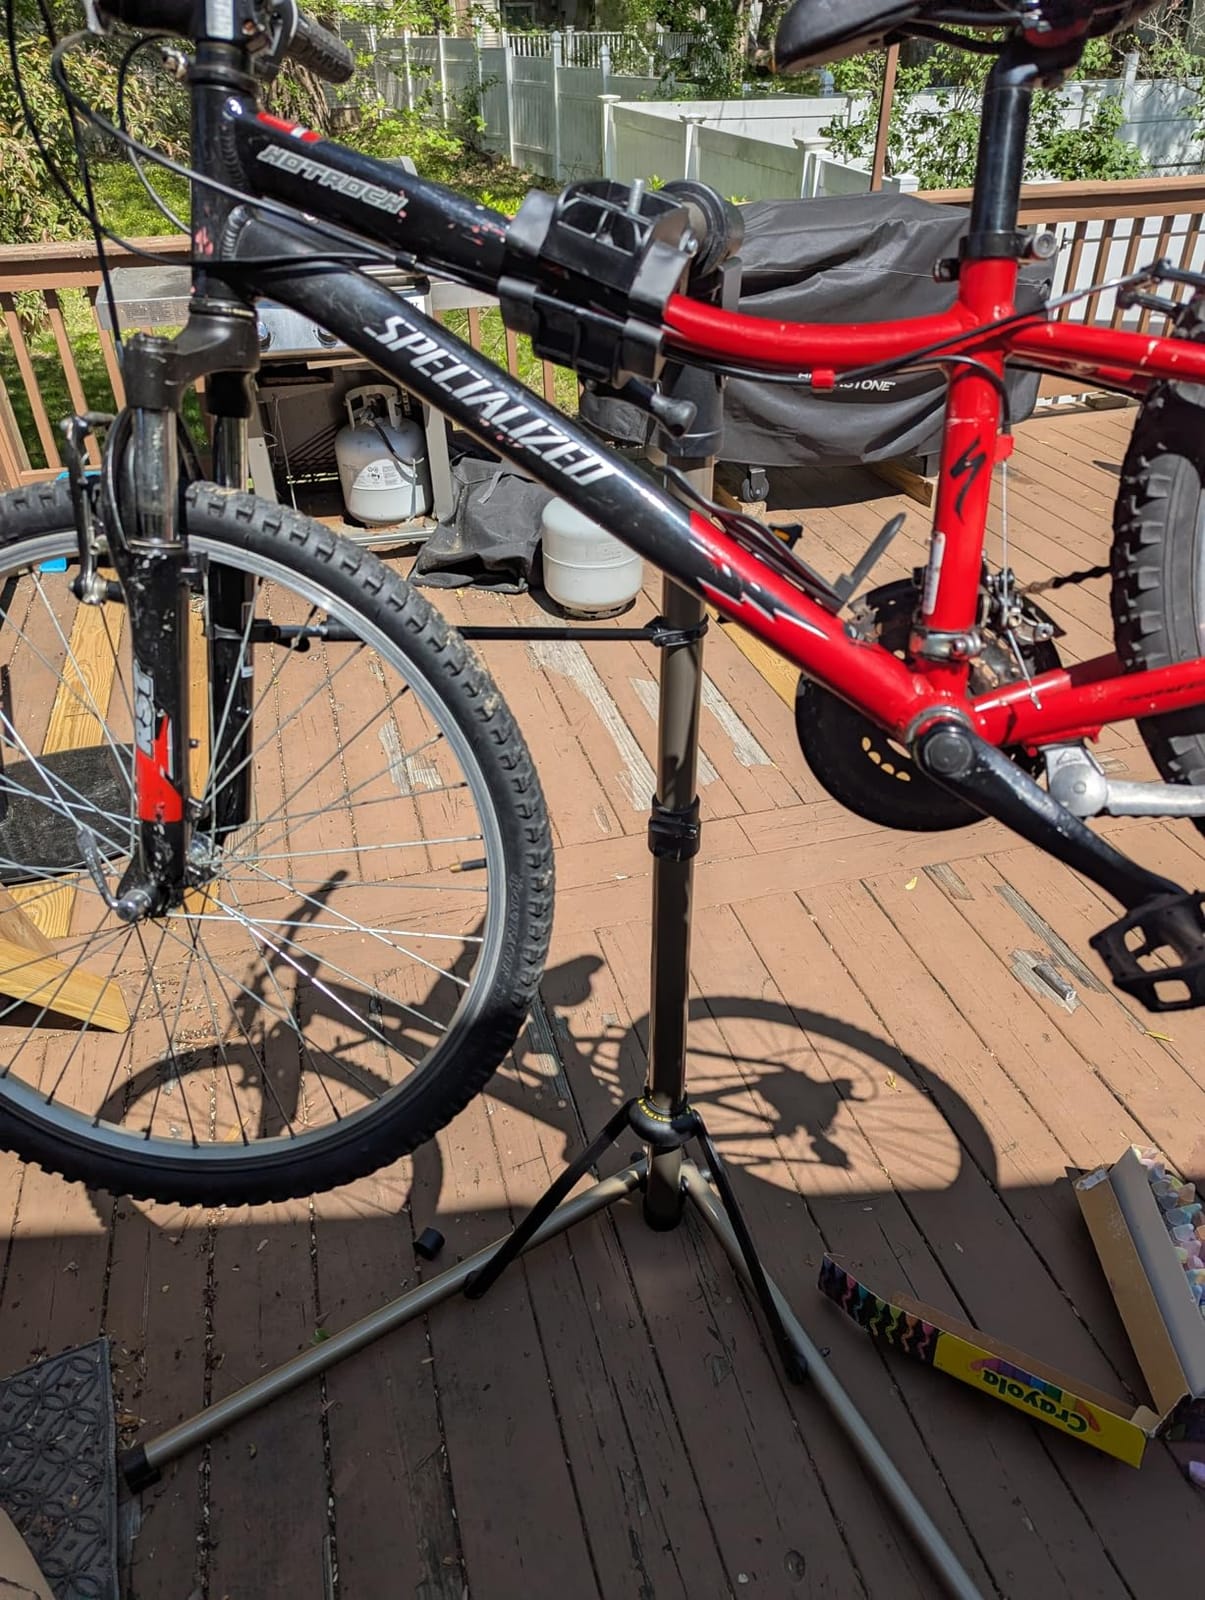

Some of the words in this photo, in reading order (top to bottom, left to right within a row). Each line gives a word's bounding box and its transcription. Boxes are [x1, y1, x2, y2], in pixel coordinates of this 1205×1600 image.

[256, 144, 409, 214] HOTROCK
[363, 315, 615, 486] SPECIALIZED
[133, 659, 154, 757] RST
[983, 1368, 1088, 1433] Crayola
